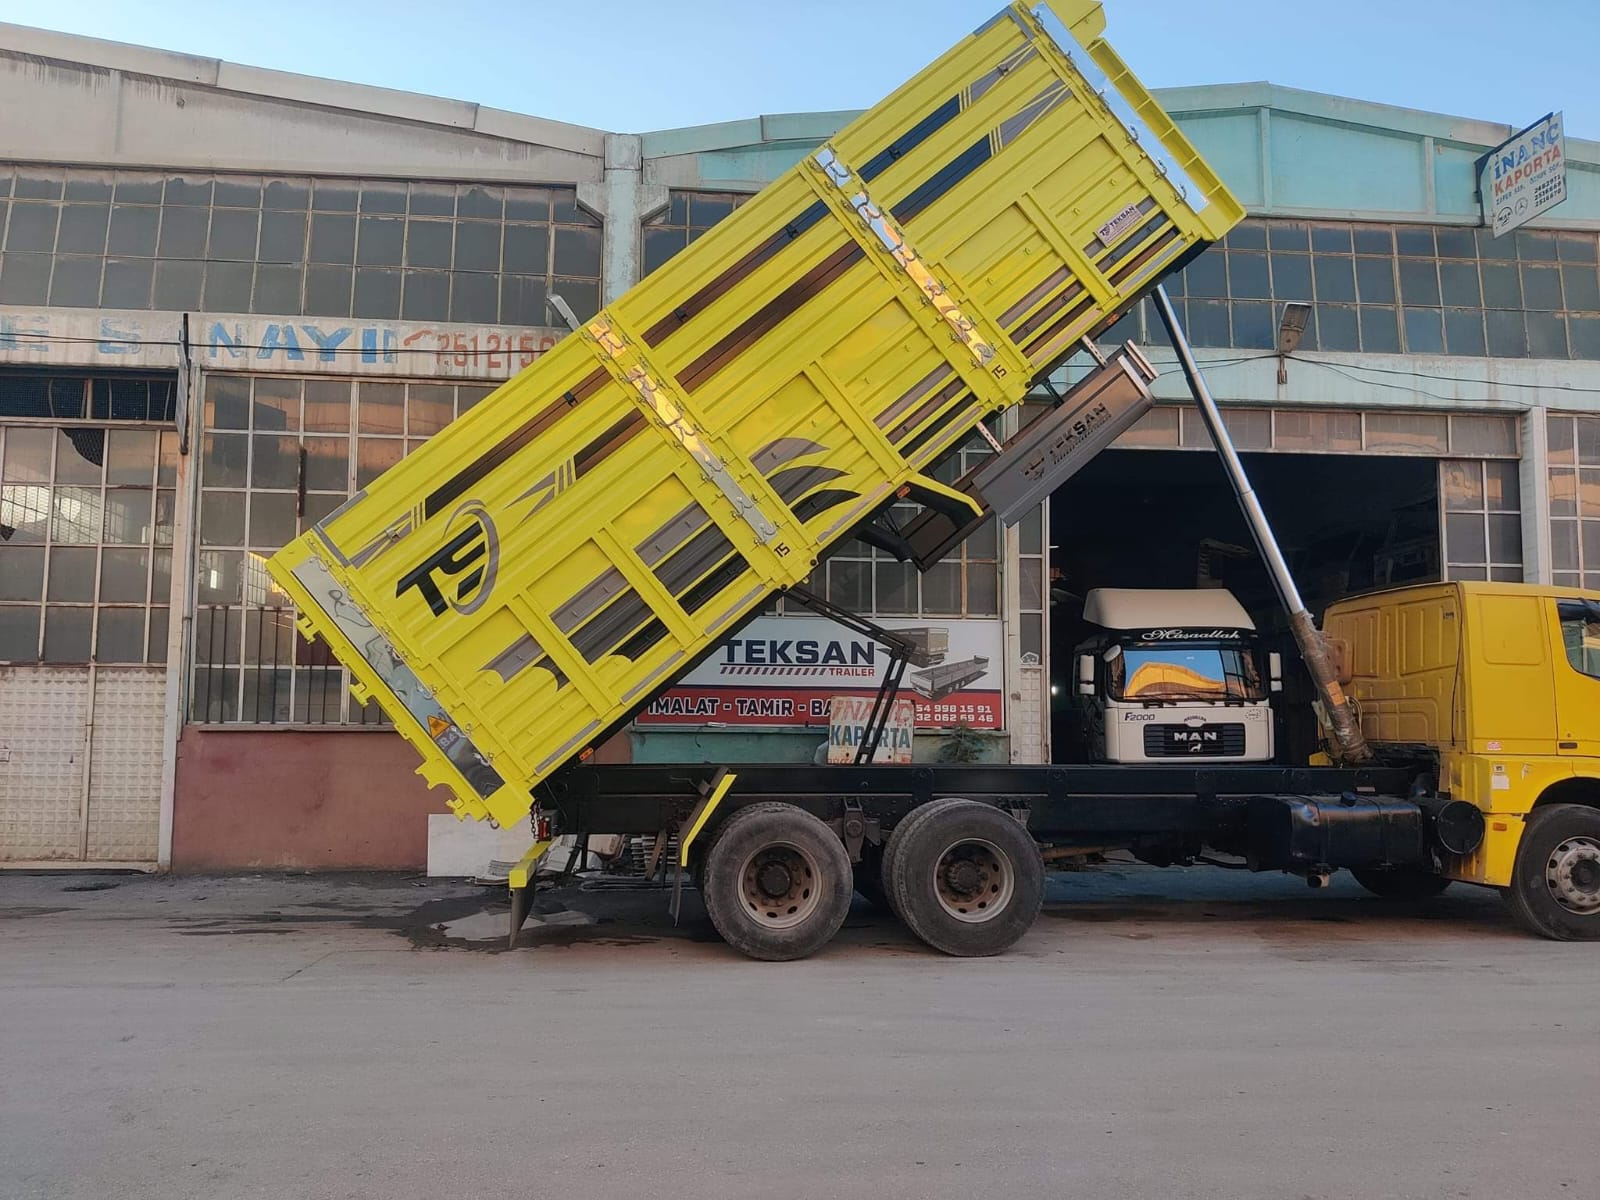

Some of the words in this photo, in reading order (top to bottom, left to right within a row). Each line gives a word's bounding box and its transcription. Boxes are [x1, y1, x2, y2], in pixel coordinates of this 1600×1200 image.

[1495, 144, 1561, 197] KAPORTA
[721, 639, 875, 665] TEKSAN
[829, 667, 875, 677] TRAILER
[1124, 711, 1156, 721] F2000
[1173, 732, 1218, 741] MAN
